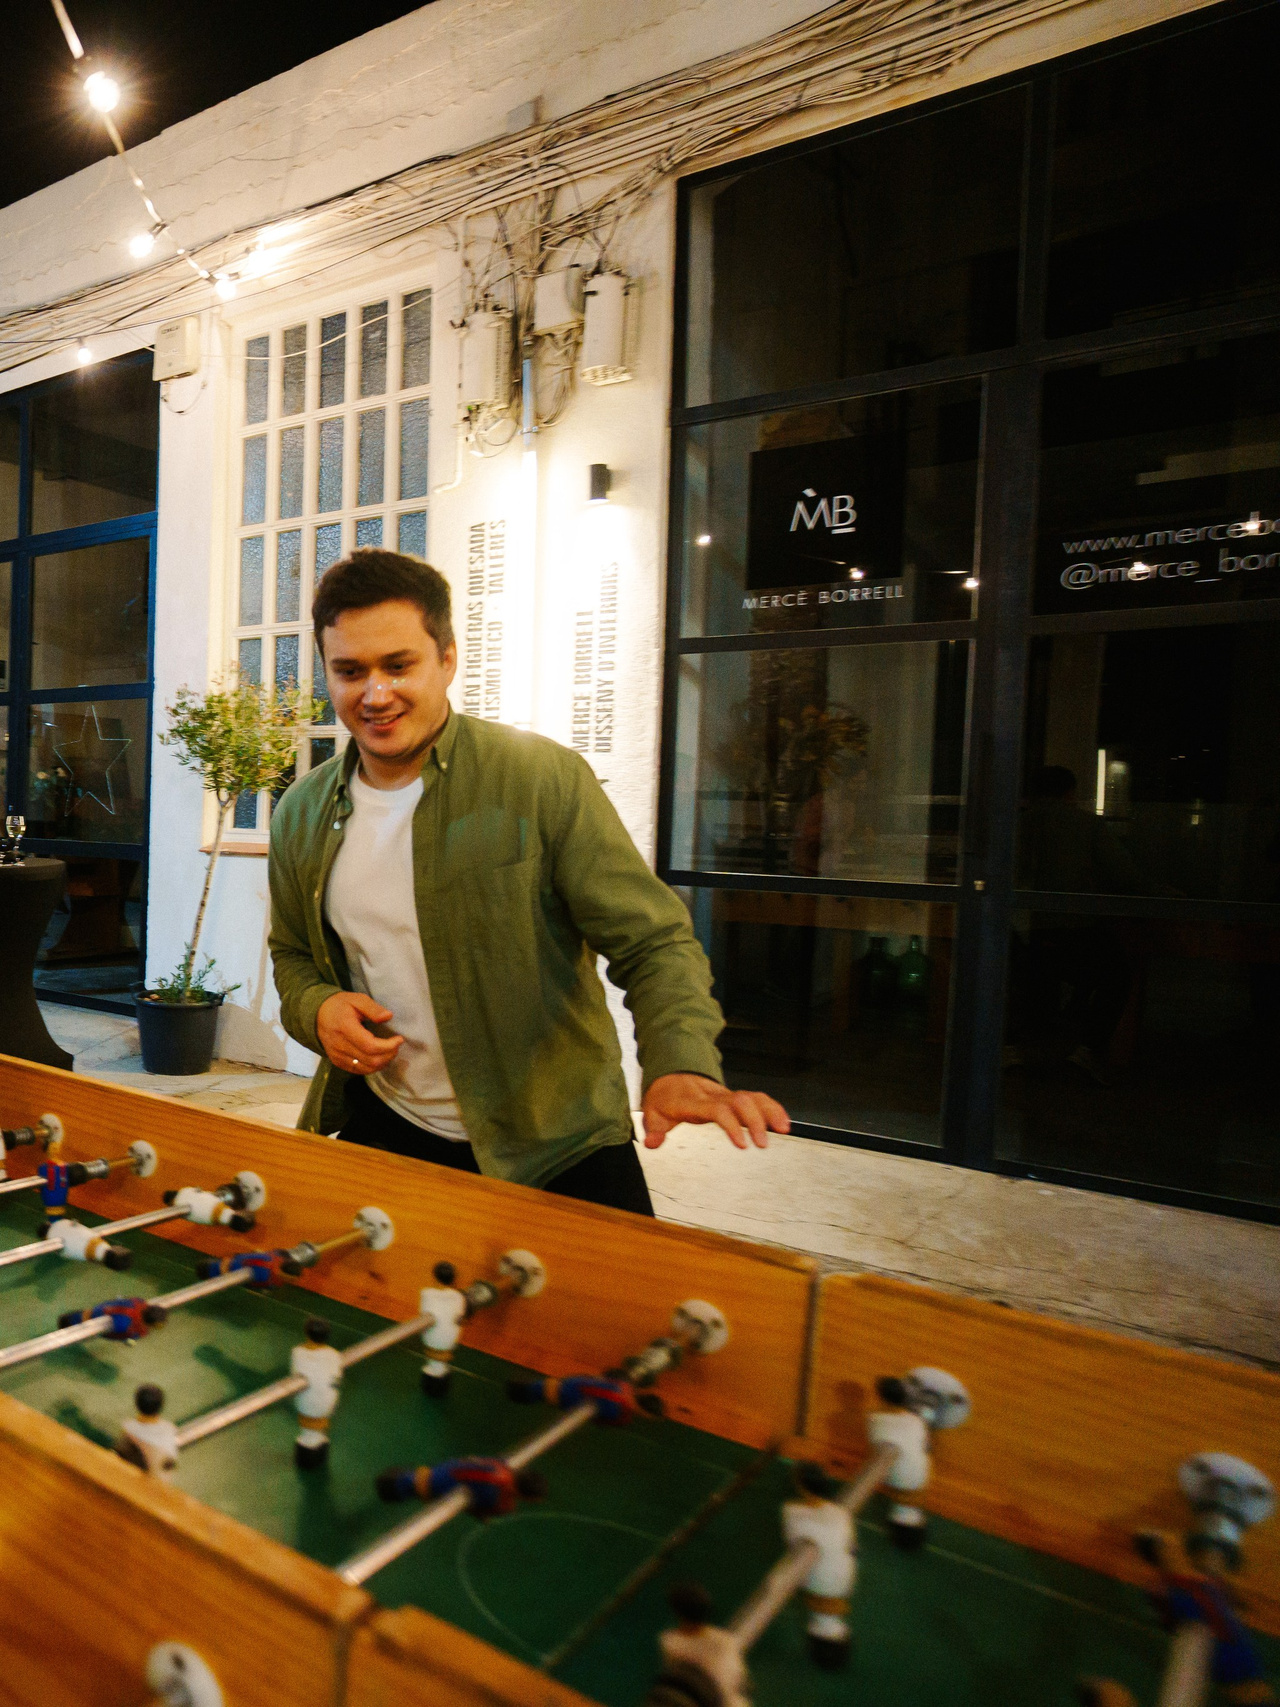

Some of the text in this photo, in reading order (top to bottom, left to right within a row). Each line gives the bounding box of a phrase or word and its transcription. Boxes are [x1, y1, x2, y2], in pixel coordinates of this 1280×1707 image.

[467, 522, 485, 596] QUESADA
[488, 519, 506, 595] TALLERES
[818, 585, 905, 604] BORRELL
[465, 601, 483, 679] FIGUERAS
[486, 621, 503, 662] DECO
[574, 611, 593, 684] BORRELL
[595, 561, 618, 753] DISSENY D'INTERIORS
